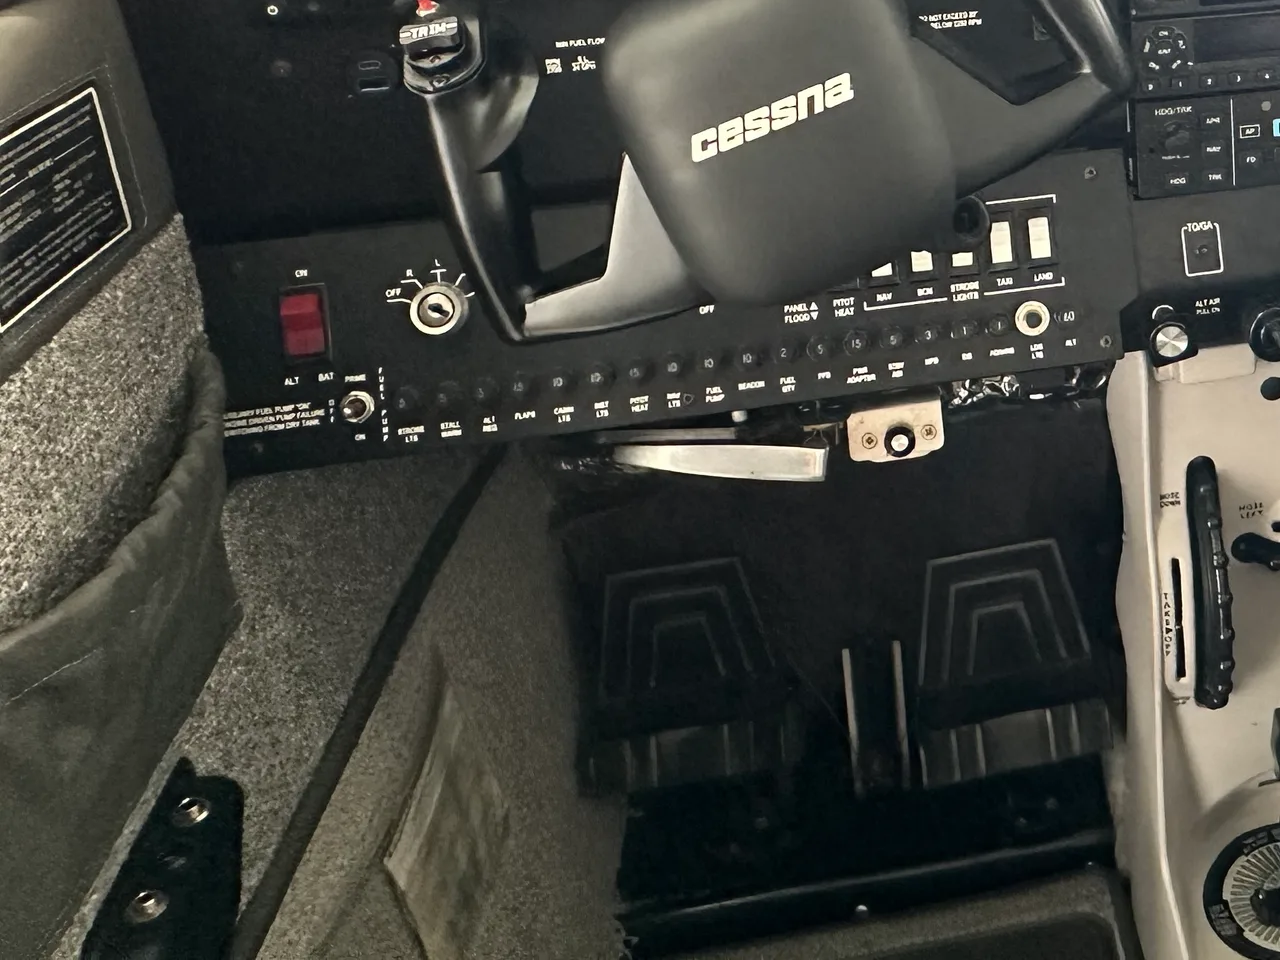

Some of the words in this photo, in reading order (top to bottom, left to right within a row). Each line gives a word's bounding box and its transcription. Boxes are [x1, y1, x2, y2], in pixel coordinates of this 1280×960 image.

[408, 22, 447, 40] TRIM
[295, 269, 308, 278] ON
[406, 269, 414, 277] R
[1033, 271, 1054, 282] LAND
[385, 288, 402, 298] OFF
[876, 293, 893, 302] NAV
[833, 297, 855, 307] PITOT
[1195, 299, 1209, 307] ALT
[1209, 297, 1221, 306] AIR
[699, 304, 715, 315] OFF
[784, 303, 808, 313] PANEL
[834, 306, 854, 317] HEAT
[784, 313, 810, 323] FLOOD
[851, 339, 862, 349] 15
[780, 348, 787, 358] 2
[704, 358, 714, 368] 10
[743, 353, 753, 364] 10
[284, 376, 300, 386] ALT
[318, 372, 335, 382] BAT
[344, 373, 367, 383] PRIME
[779, 377, 796, 385] FUEL
[378, 367, 386, 400] FUEL
[738, 380, 766, 391] BEACON
[706, 386, 723, 395] FUEL
[255, 406, 274, 416] FUEL
[276, 413, 296, 422] PUMP
[296, 408, 325, 419] FAILURE
[514, 411, 536, 420] FLAPS
[264, 423, 285, 432] FROM
[285, 421, 301, 430] DRY
[301, 418, 320, 427] TANK
[381, 410, 389, 442] PUMP
[405, 434, 419, 442] LTS
